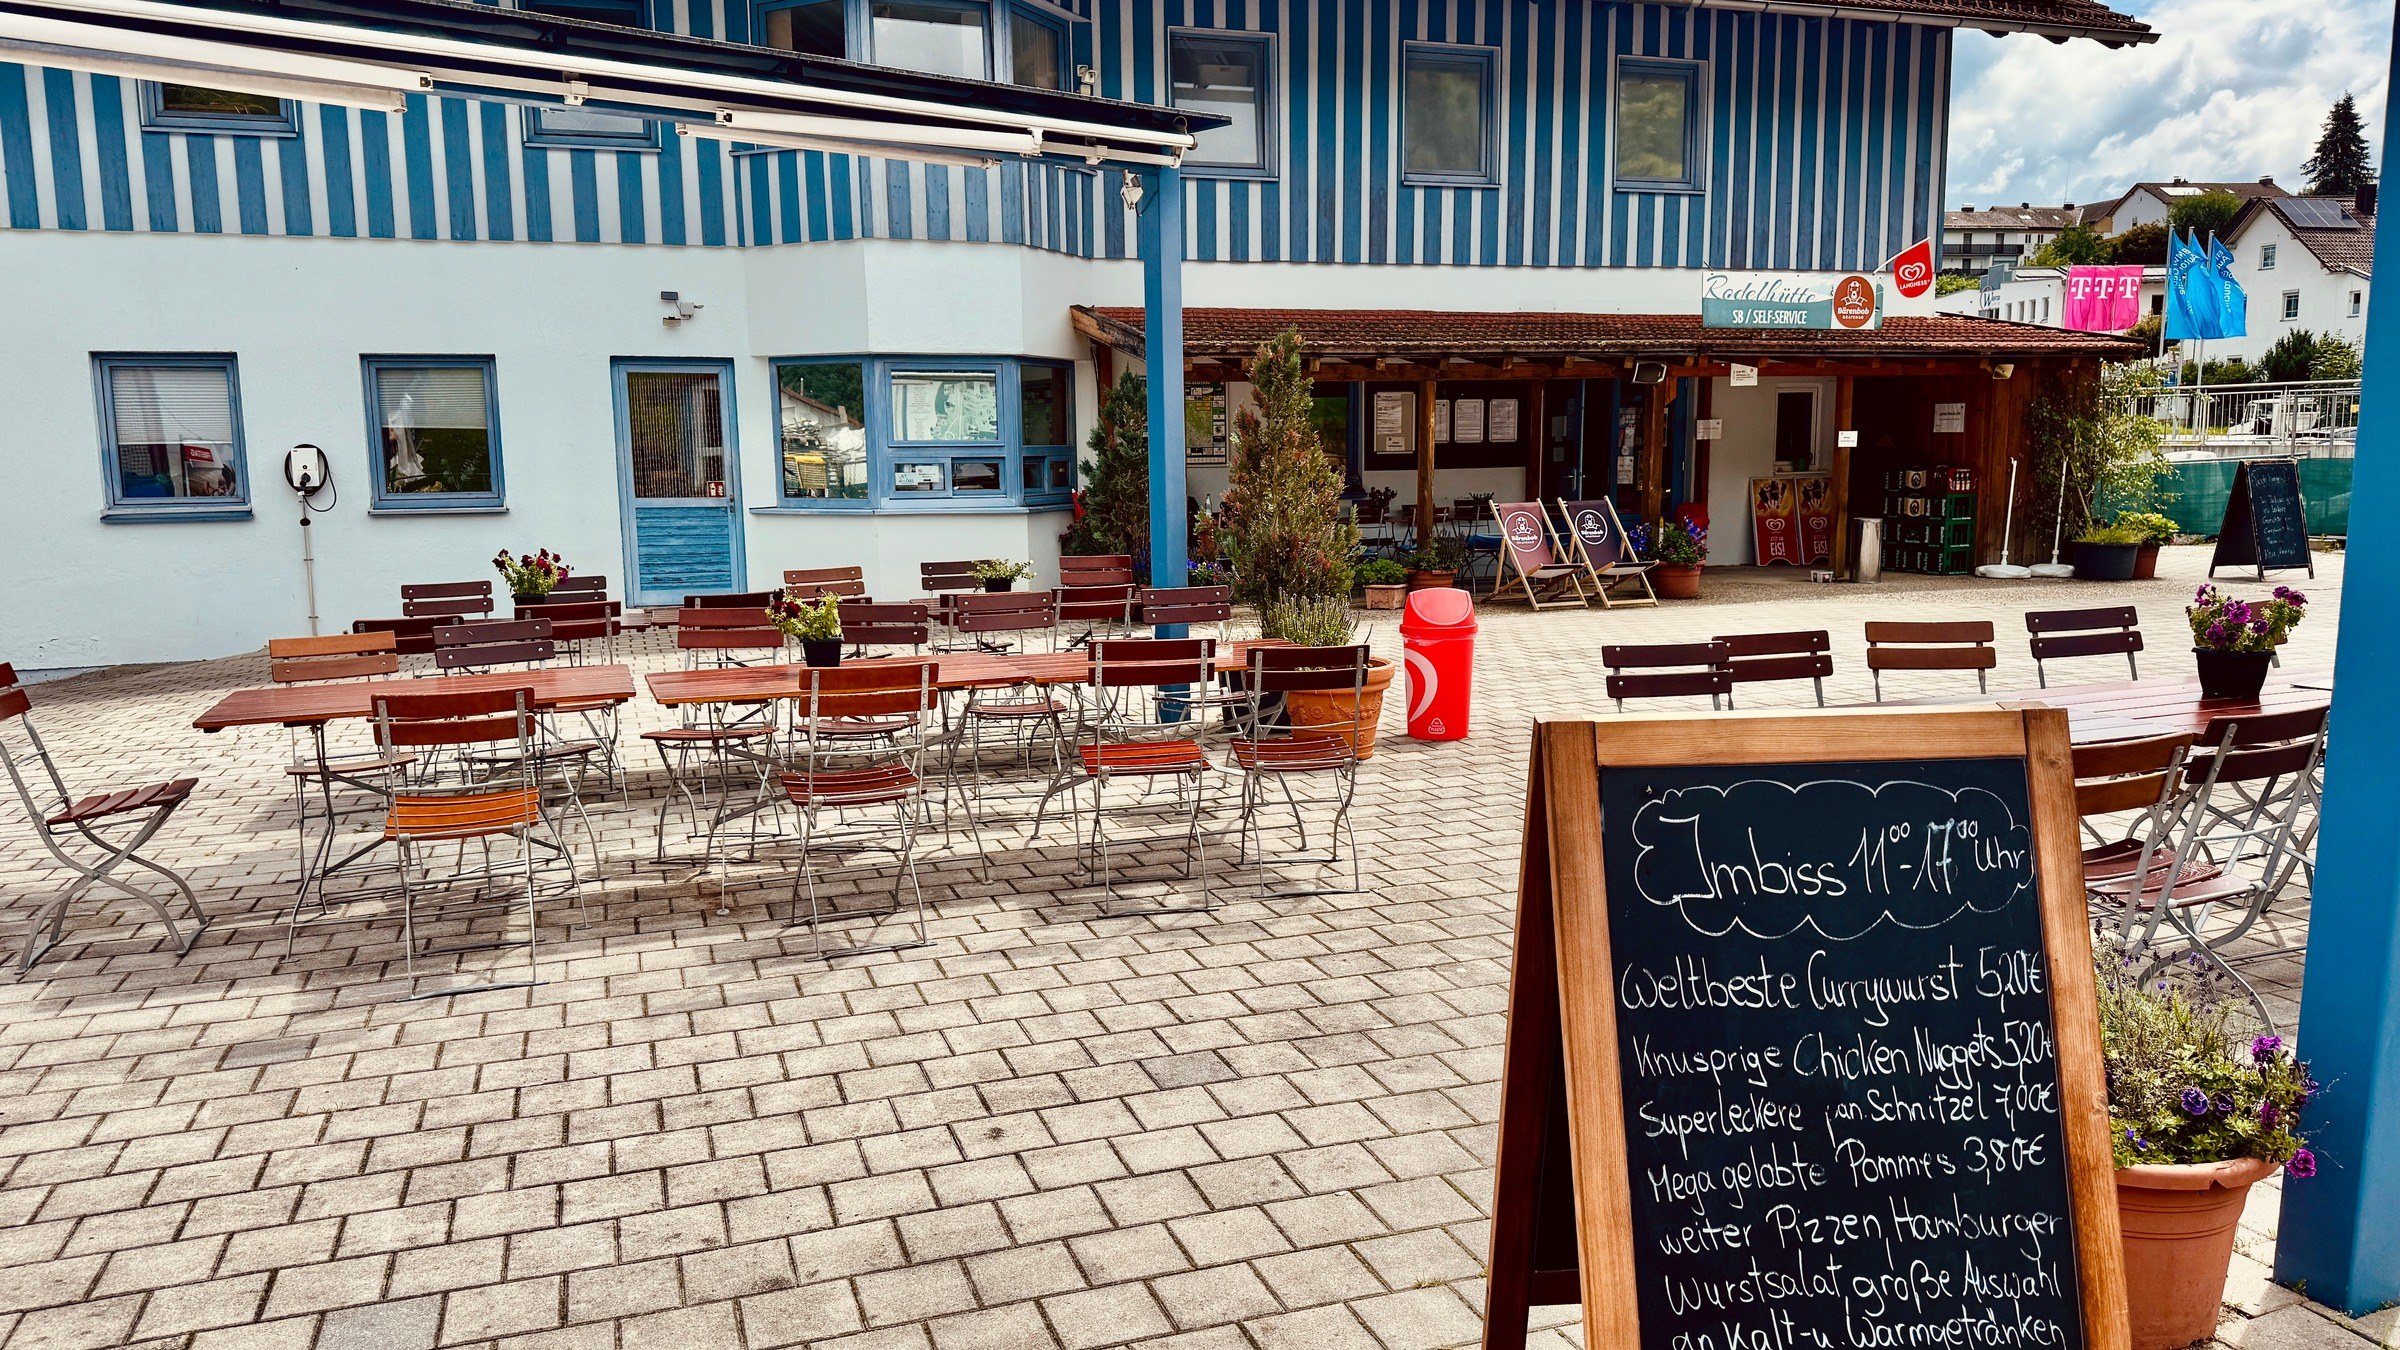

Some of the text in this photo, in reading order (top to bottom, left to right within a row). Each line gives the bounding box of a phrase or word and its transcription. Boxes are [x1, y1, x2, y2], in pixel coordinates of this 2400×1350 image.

[1704, 274, 1816, 304] Rodelhütte
[1732, 309, 1808, 325] SB / SELF-SERVICE
[1837, 307, 1870, 315] Bärenbob
[2071, 276, 2140, 300] T T T
[1658, 813, 1848, 900] Imbiss
[1974, 836, 2025, 872] Uhr
[1621, 953, 1800, 1010] Weltbeste
[1807, 944, 1964, 1027] Currywurst
[1632, 1033, 1784, 1088] Knusprige
[1793, 1031, 1911, 1081] Chicken
[1913, 1017, 2002, 1091] Nuggets
[1639, 1088, 1804, 1161] Superleckere
[1866, 1080, 1990, 1125] Schnitzel
[1992, 1082, 2058, 1132] 7,00€
[1647, 1133, 2047, 1216] Mega gelobte Pommes 3,80€
[1659, 1218, 1752, 1255] weiter
[1889, 1192, 2063, 1261] Hamburger
[1852, 1259, 1953, 1318] große
[1962, 1250, 2063, 1304] Auswahl
[1845, 1298, 2068, 1350] Warmgetränken
